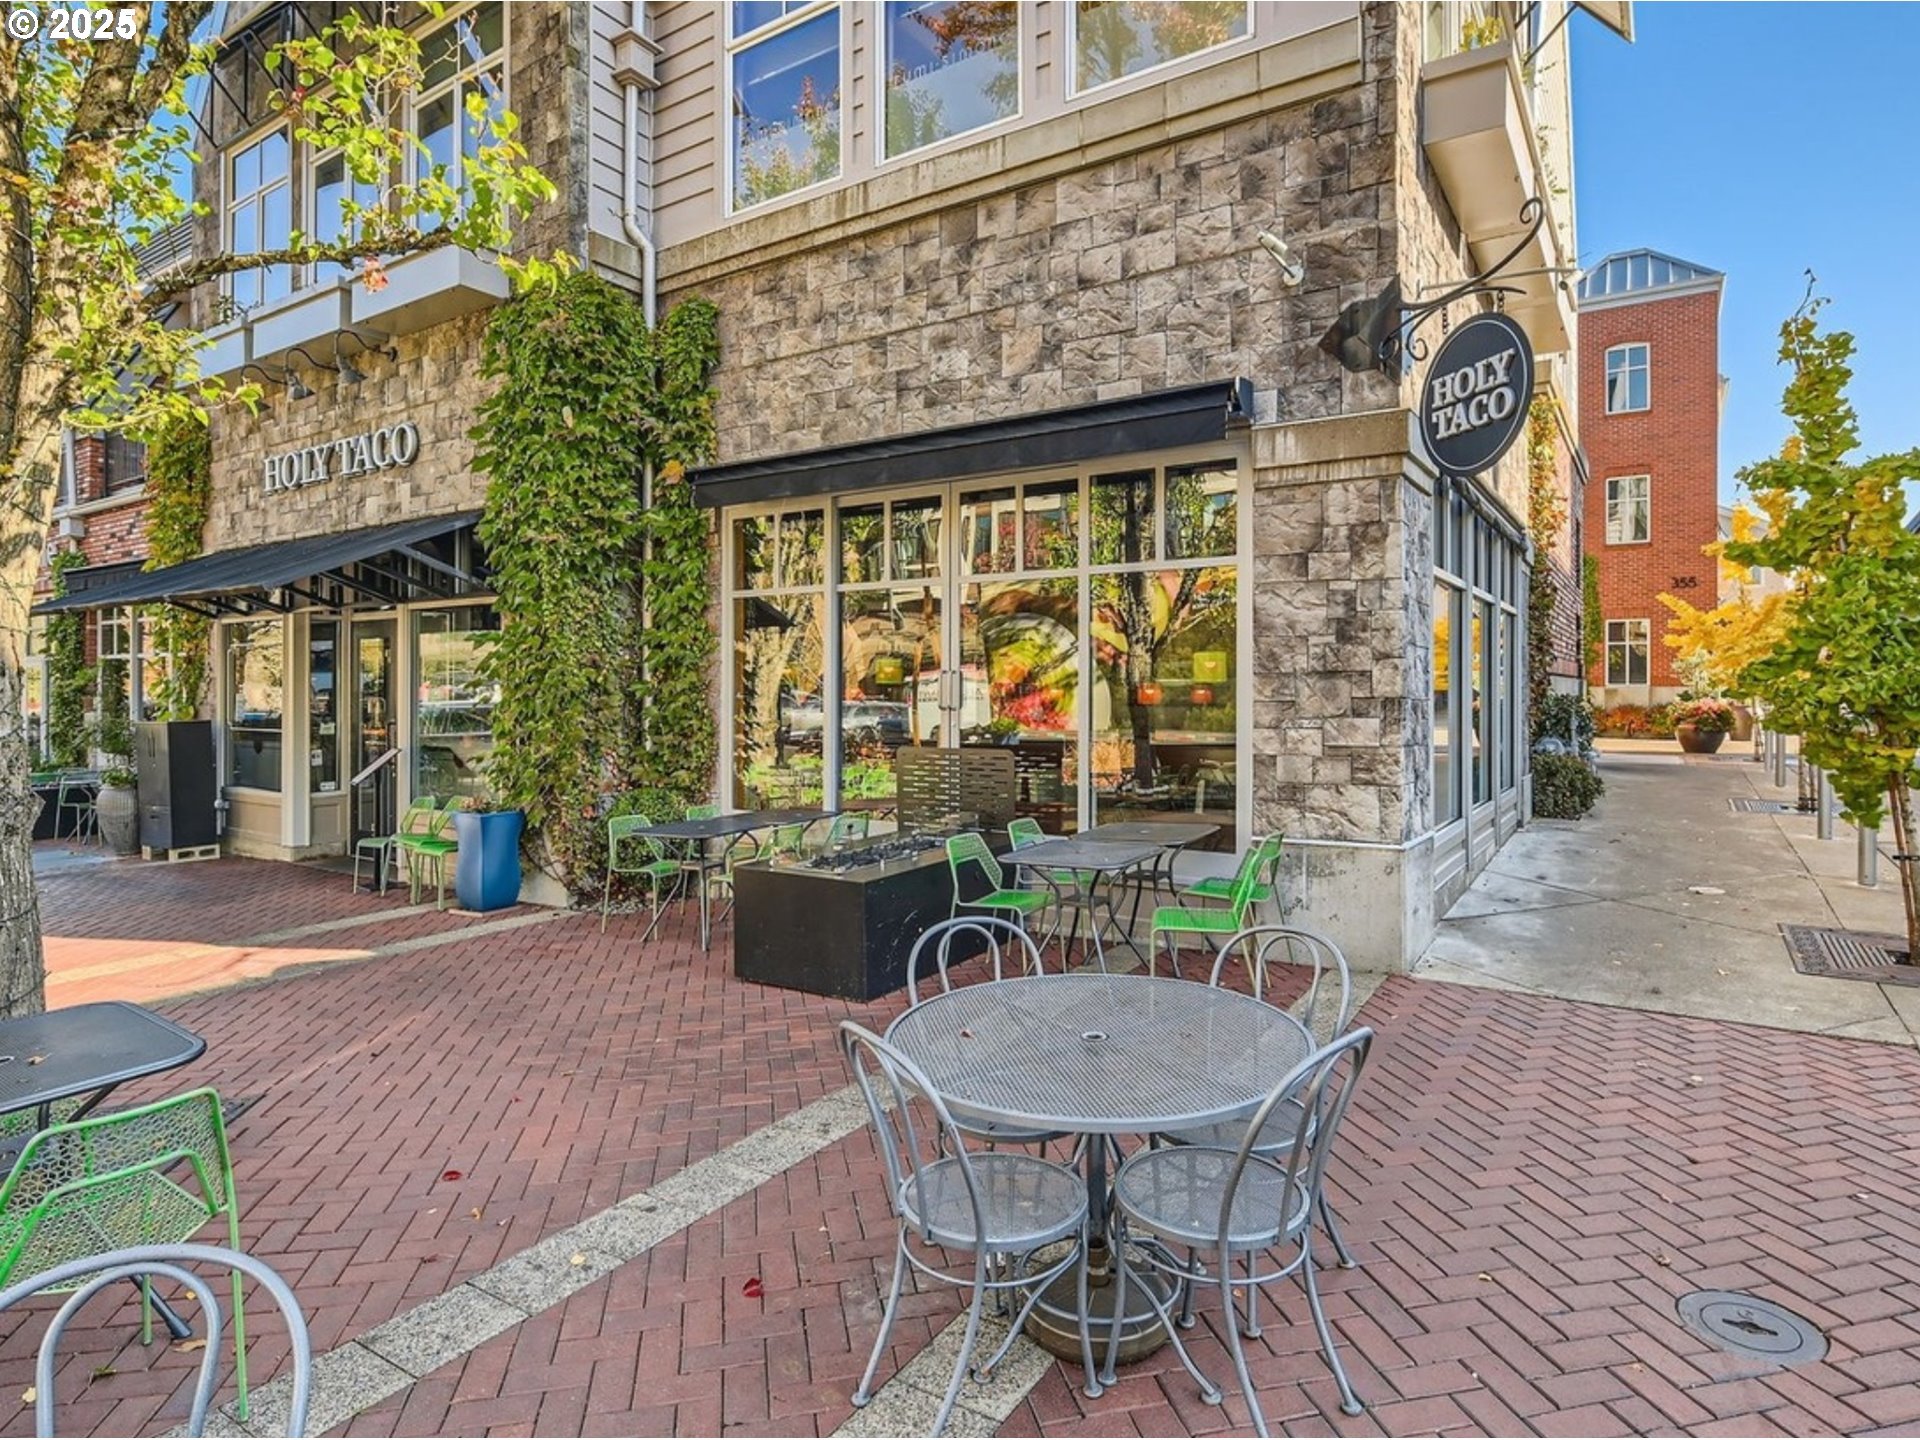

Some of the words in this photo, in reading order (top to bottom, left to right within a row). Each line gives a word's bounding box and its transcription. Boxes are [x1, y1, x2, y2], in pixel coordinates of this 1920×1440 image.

[1431, 347, 1517, 409] HOLY
[1431, 385, 1517, 441] TACO
[263, 441, 334, 496] HOLY
[335, 421, 420, 478] TACO
[1671, 576, 1698, 589] 355
